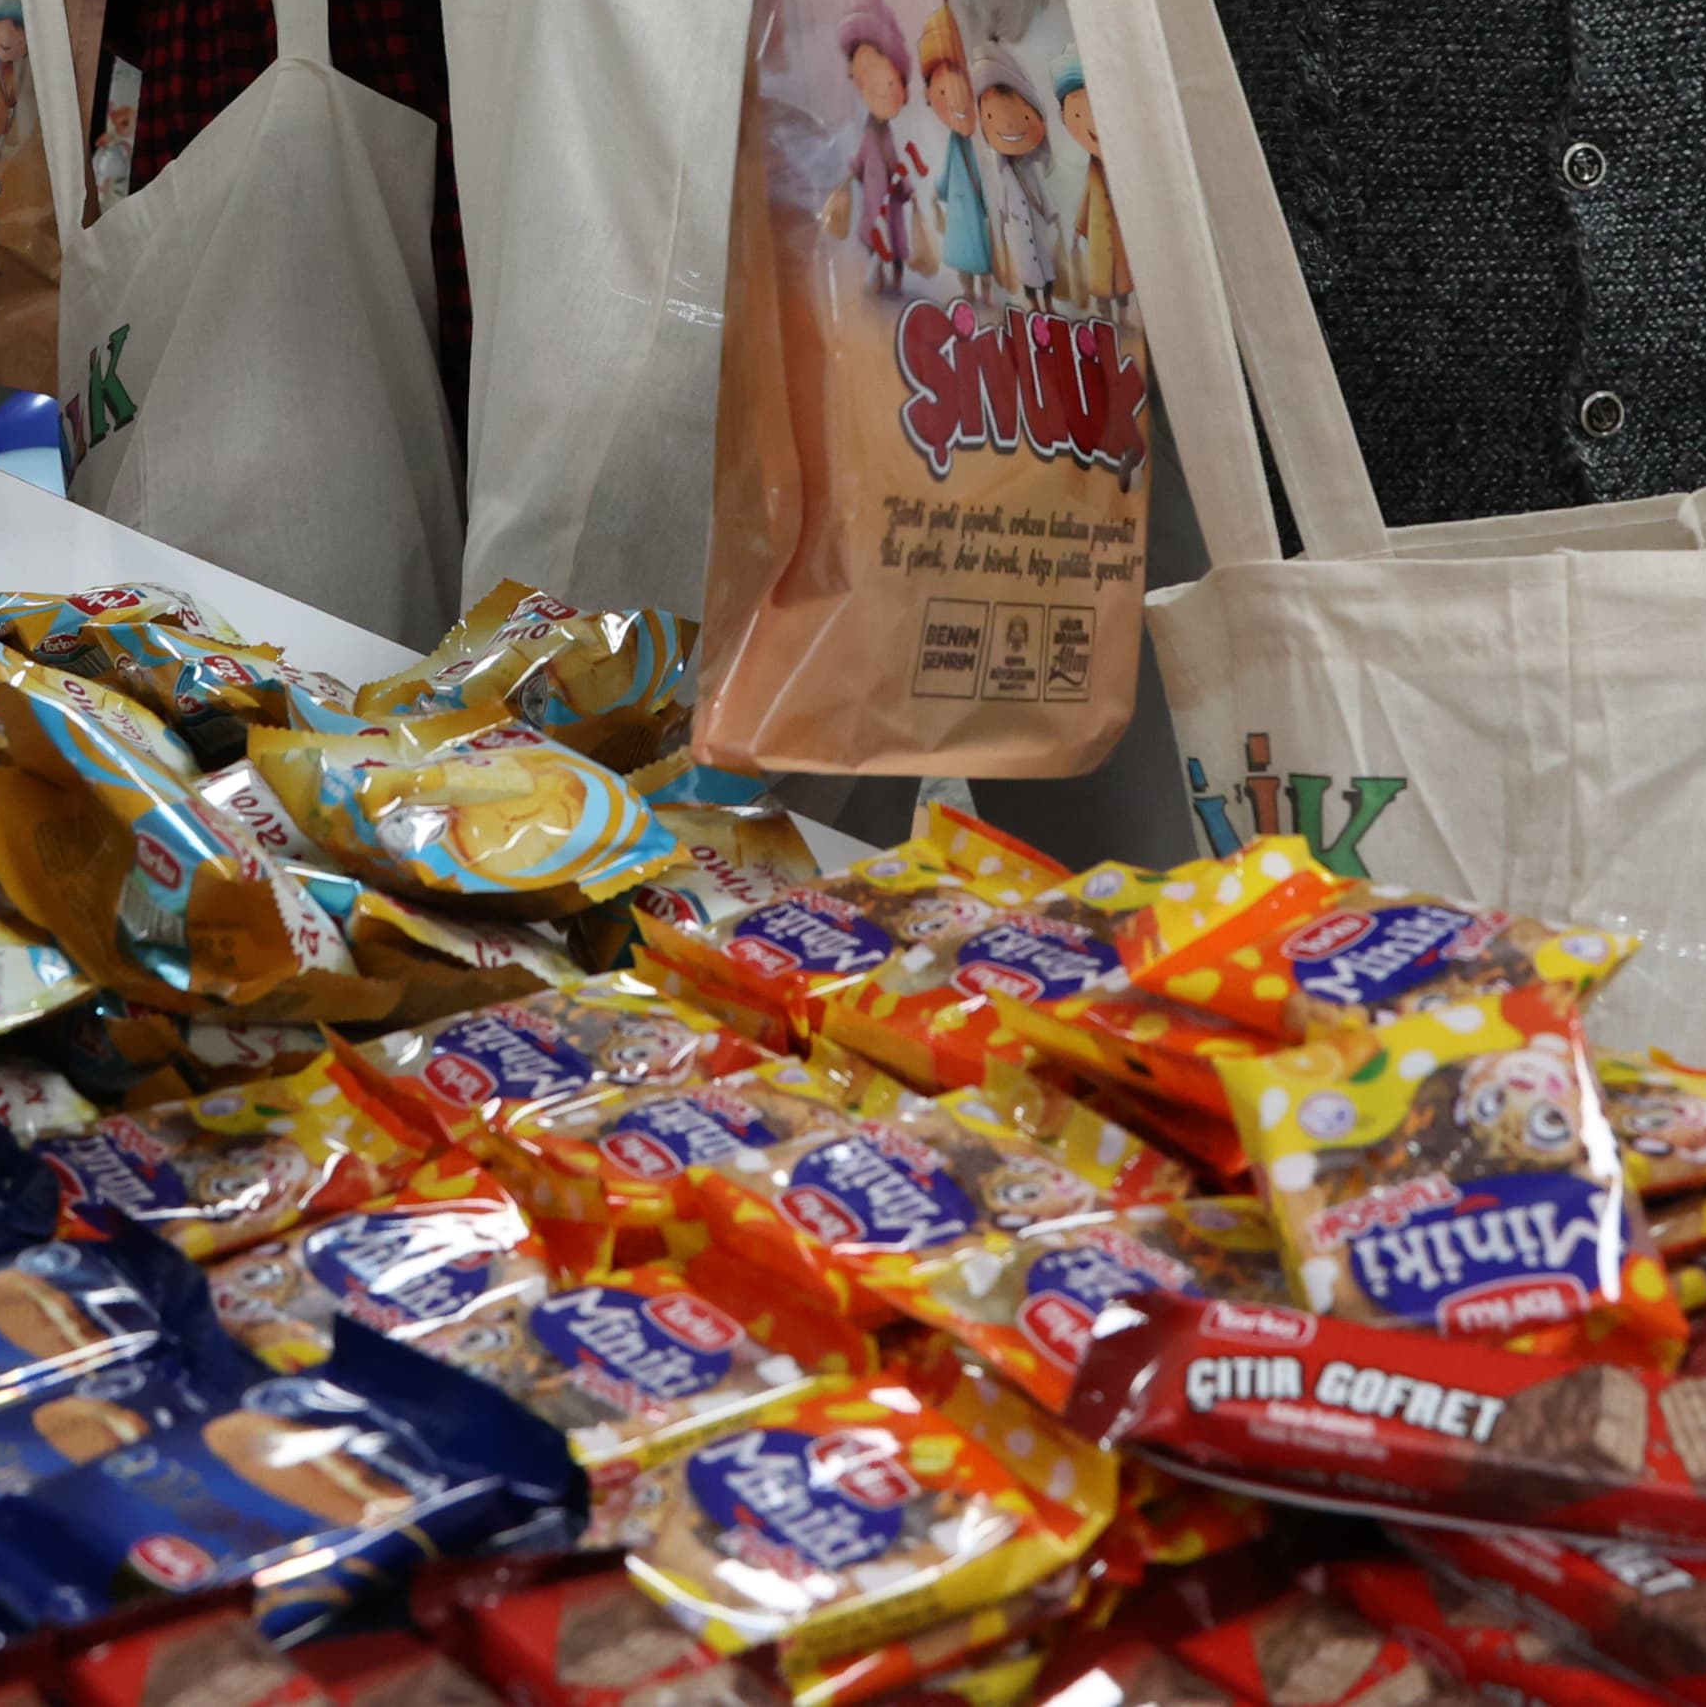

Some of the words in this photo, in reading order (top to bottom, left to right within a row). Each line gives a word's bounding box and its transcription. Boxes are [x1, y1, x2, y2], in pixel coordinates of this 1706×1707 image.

[1304, 904, 1471, 1005] Miniki
[1351, 1190, 1625, 1299] Miniki
[544, 1287, 713, 1394] Miniki
[1186, 1357, 1303, 1414] ÇITIR
[1315, 1360, 1506, 1443] GOFRET
